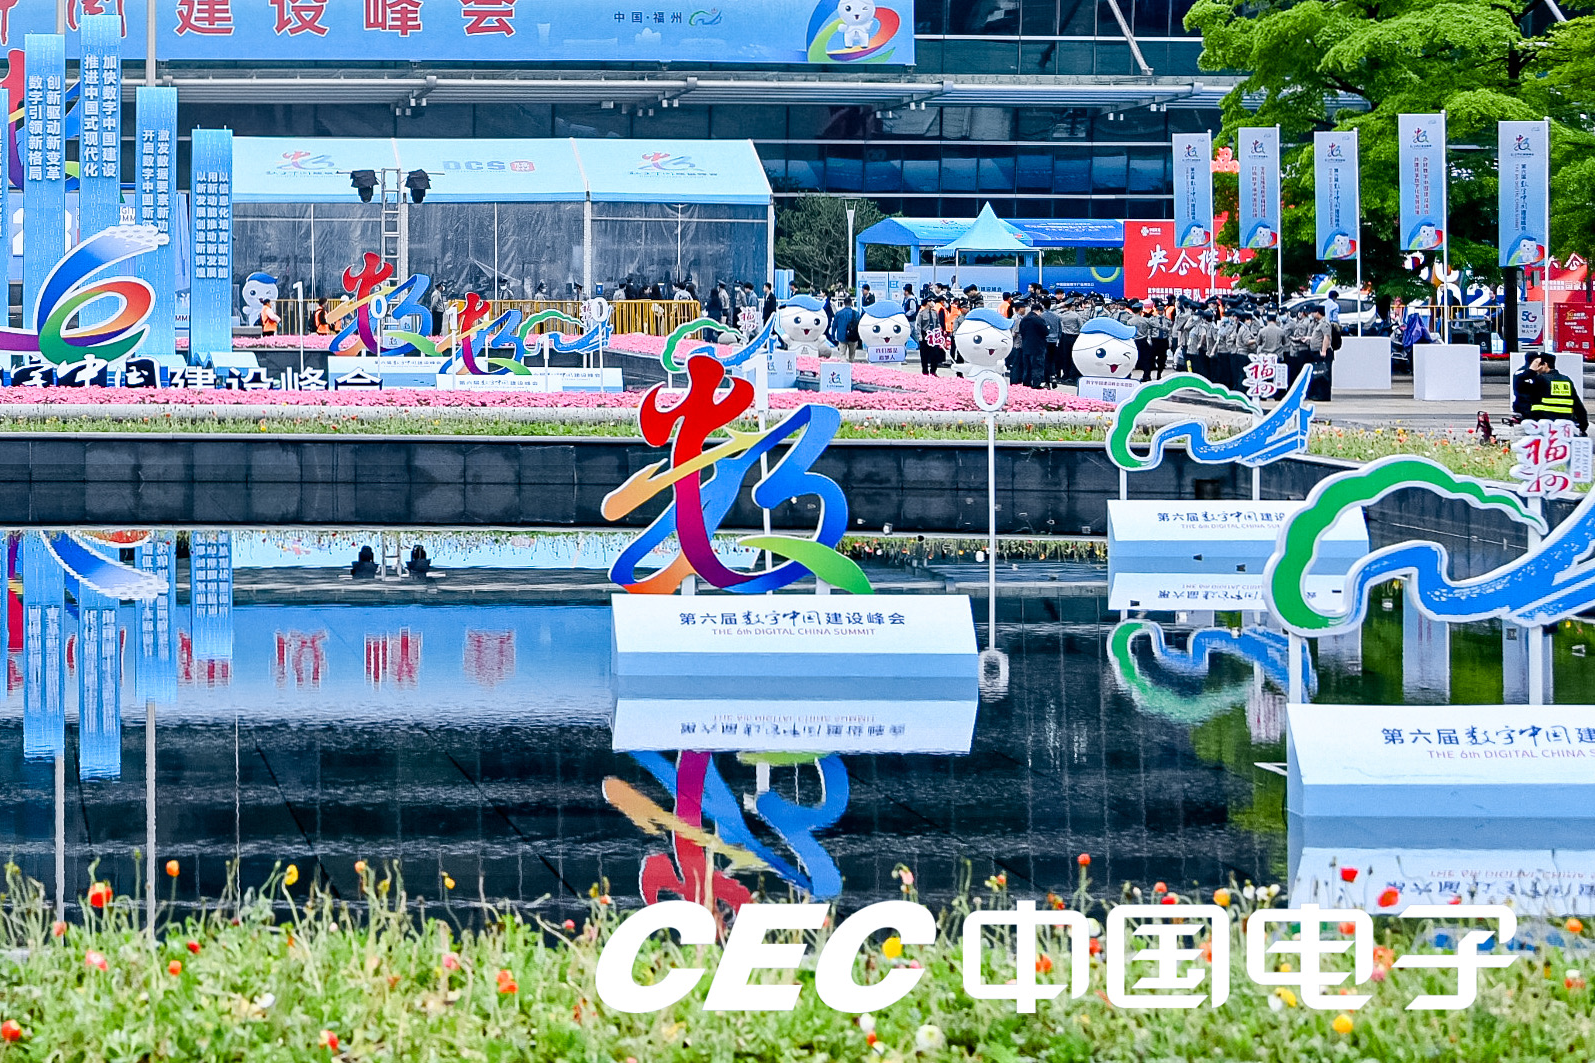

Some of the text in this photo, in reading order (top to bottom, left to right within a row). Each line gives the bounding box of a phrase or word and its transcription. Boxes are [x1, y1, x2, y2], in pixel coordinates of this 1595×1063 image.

[613, 11, 683, 24] 中国·福州
[28, 75, 43, 181] 数字引领新格局
[46, 75, 61, 181] 创新驱动新变革
[84, 55, 99, 177] 推进中国式现代化
[102, 55, 117, 177] 加快数字中国建设
[142, 129, 155, 226] 开启数字中国新
[156, 129, 170, 233] 激发数据要素新功
[443, 160, 506, 170] DCS
[207, 172, 217, 278] 用新动能推动新发展
[217, 172, 229, 278] 以信息化培育新动能
[1521, 310, 1538, 323] 5G
[1553, 383, 1569, 391] 执勤
[1157, 511, 1285, 522] 第六届数字中国建设
[679, 610, 905, 627] 第六届数字中国建设峰会
[712, 628, 875, 636] THE 6th DIGITAL CHINA SUMMIT
[1427, 750, 1585, 759] THE 6th DIGITAL CHINA
